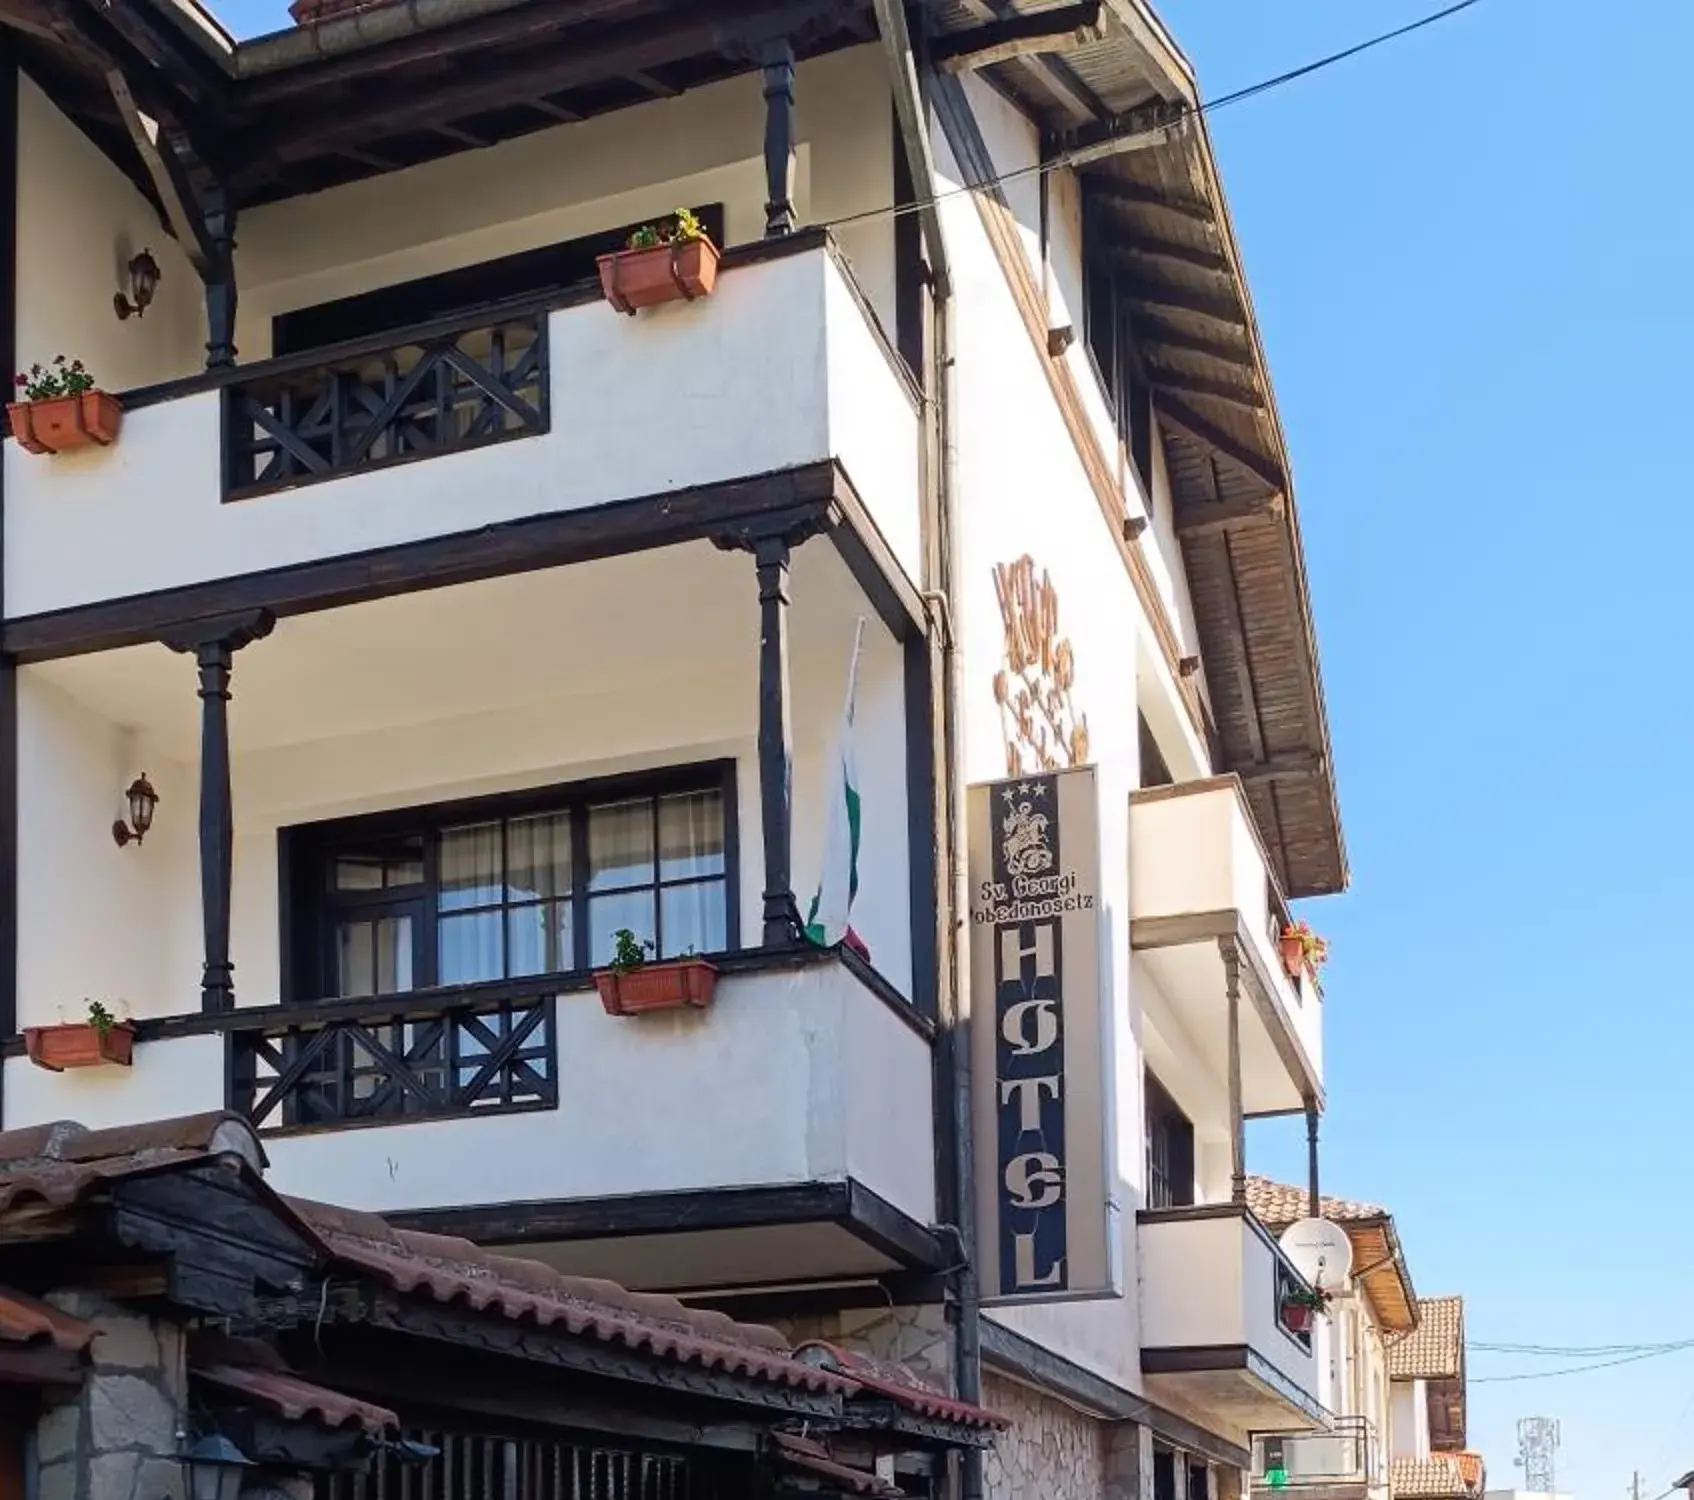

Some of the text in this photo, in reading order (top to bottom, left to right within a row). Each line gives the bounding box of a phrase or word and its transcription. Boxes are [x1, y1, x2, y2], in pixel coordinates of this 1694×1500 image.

[981, 871, 1076, 901] Sv. Georgi
[1000, 922, 1063, 1289] HOTEL
